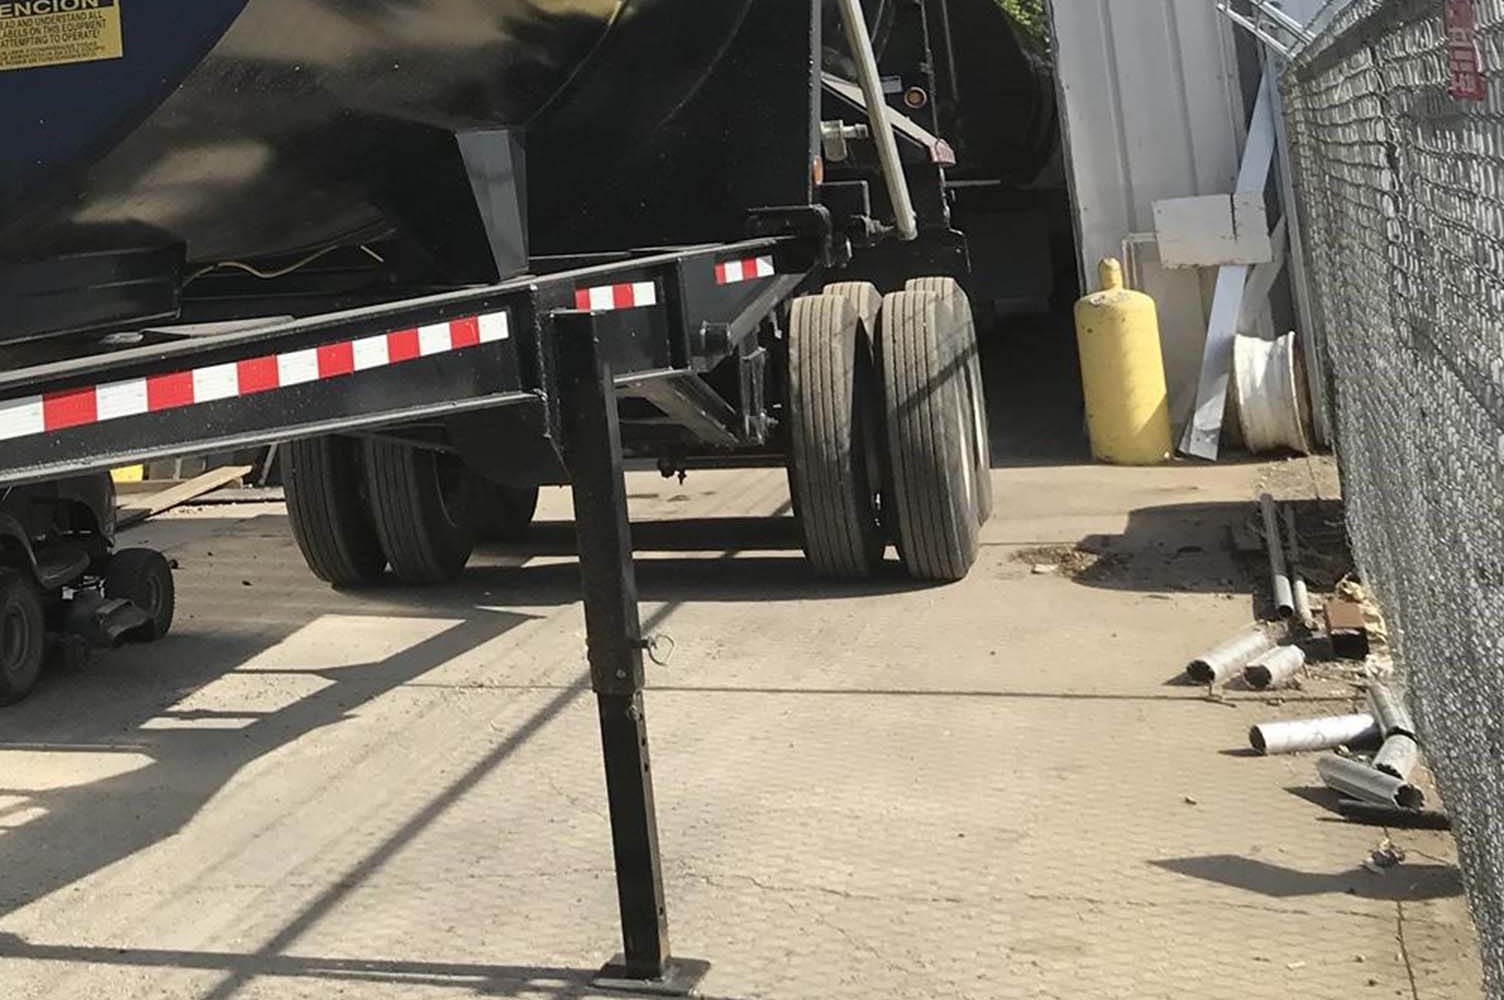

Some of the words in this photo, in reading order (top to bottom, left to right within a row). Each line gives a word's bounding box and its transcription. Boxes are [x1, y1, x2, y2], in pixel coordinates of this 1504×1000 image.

[16, 18, 32, 27] AND
[34, 12, 86, 25] UNDERSTAND
[88, 10, 102, 19] ALL
[29, 26, 42, 35] ON
[62, 19, 106, 32] EQUIPMENT
[1, 35, 48, 48] ATTEMPTING
[50, 34, 60, 43] TO
